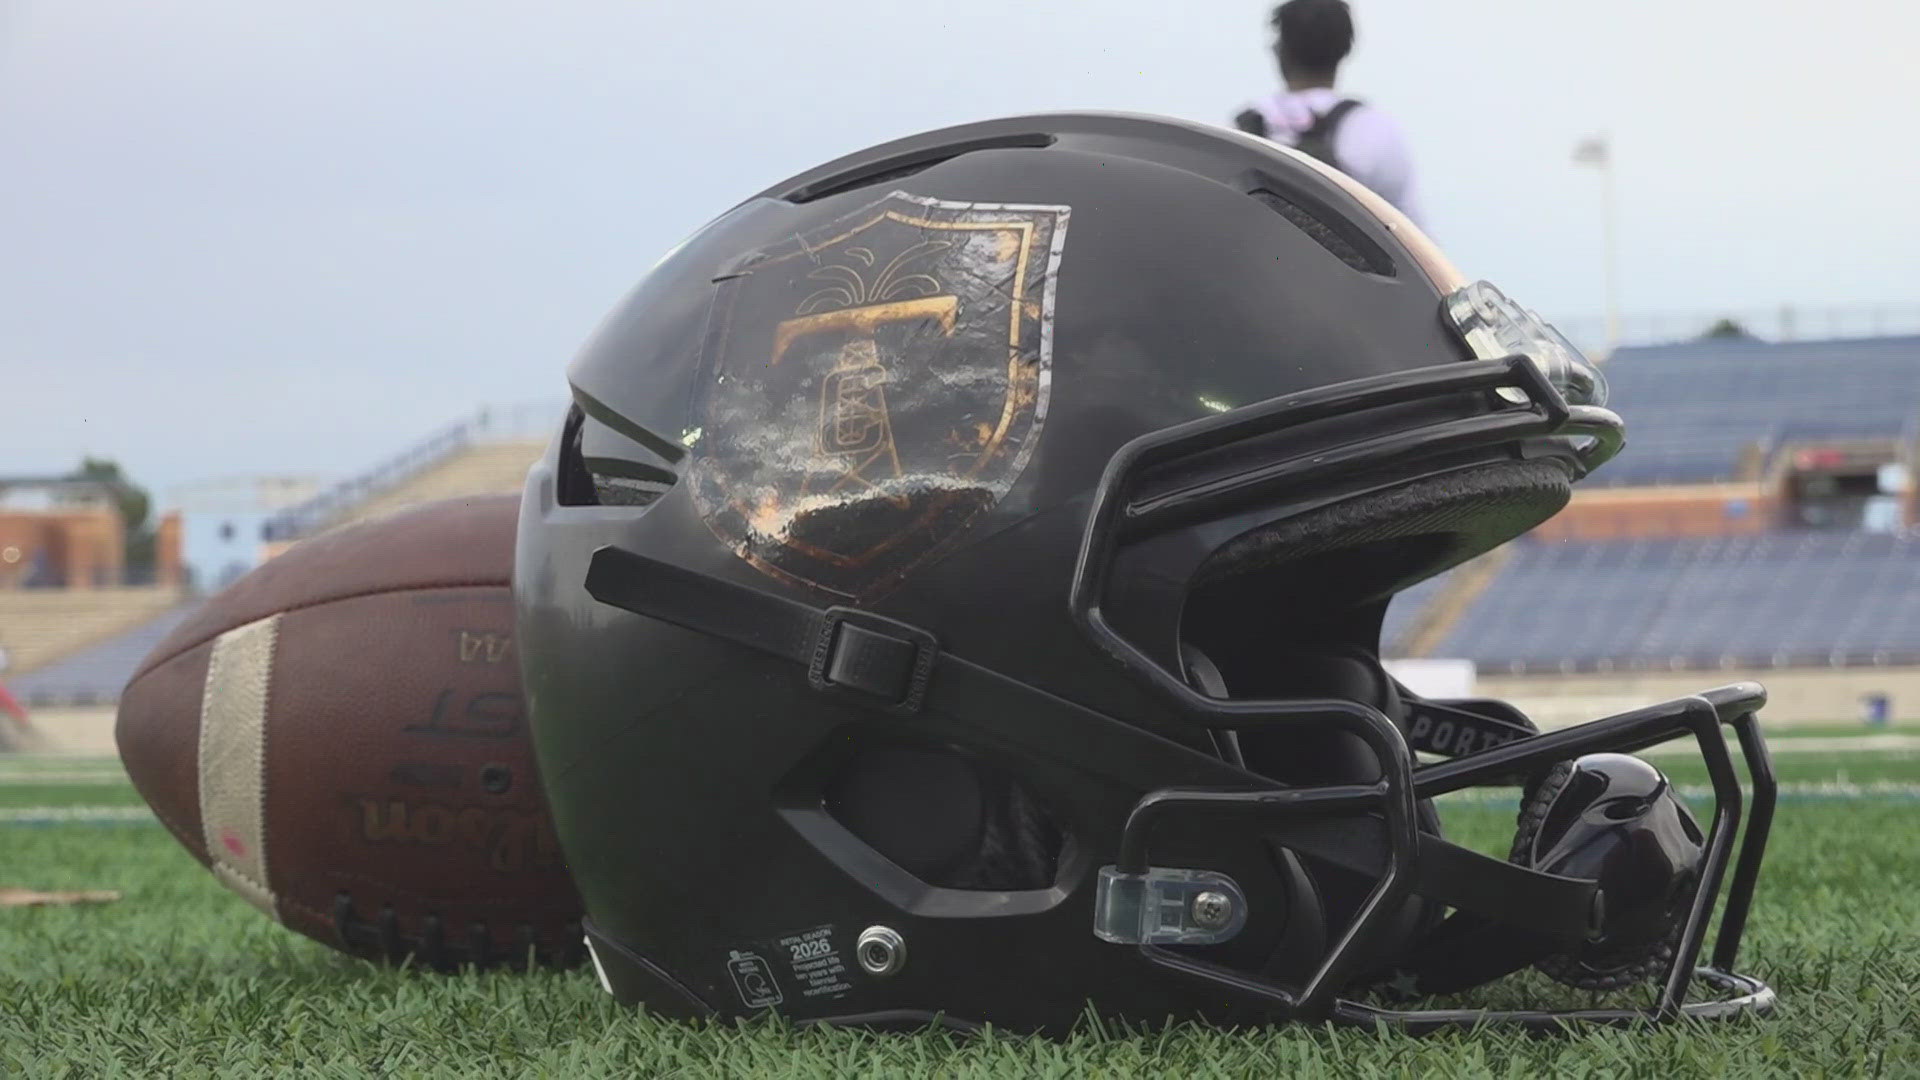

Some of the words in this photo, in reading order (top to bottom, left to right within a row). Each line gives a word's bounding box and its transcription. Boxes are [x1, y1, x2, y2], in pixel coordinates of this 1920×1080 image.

[401, 689, 522, 737] ST
[362, 799, 557, 872] ilson
[790, 938, 831, 959] 2026
[803, 928, 832, 941] SEASON
